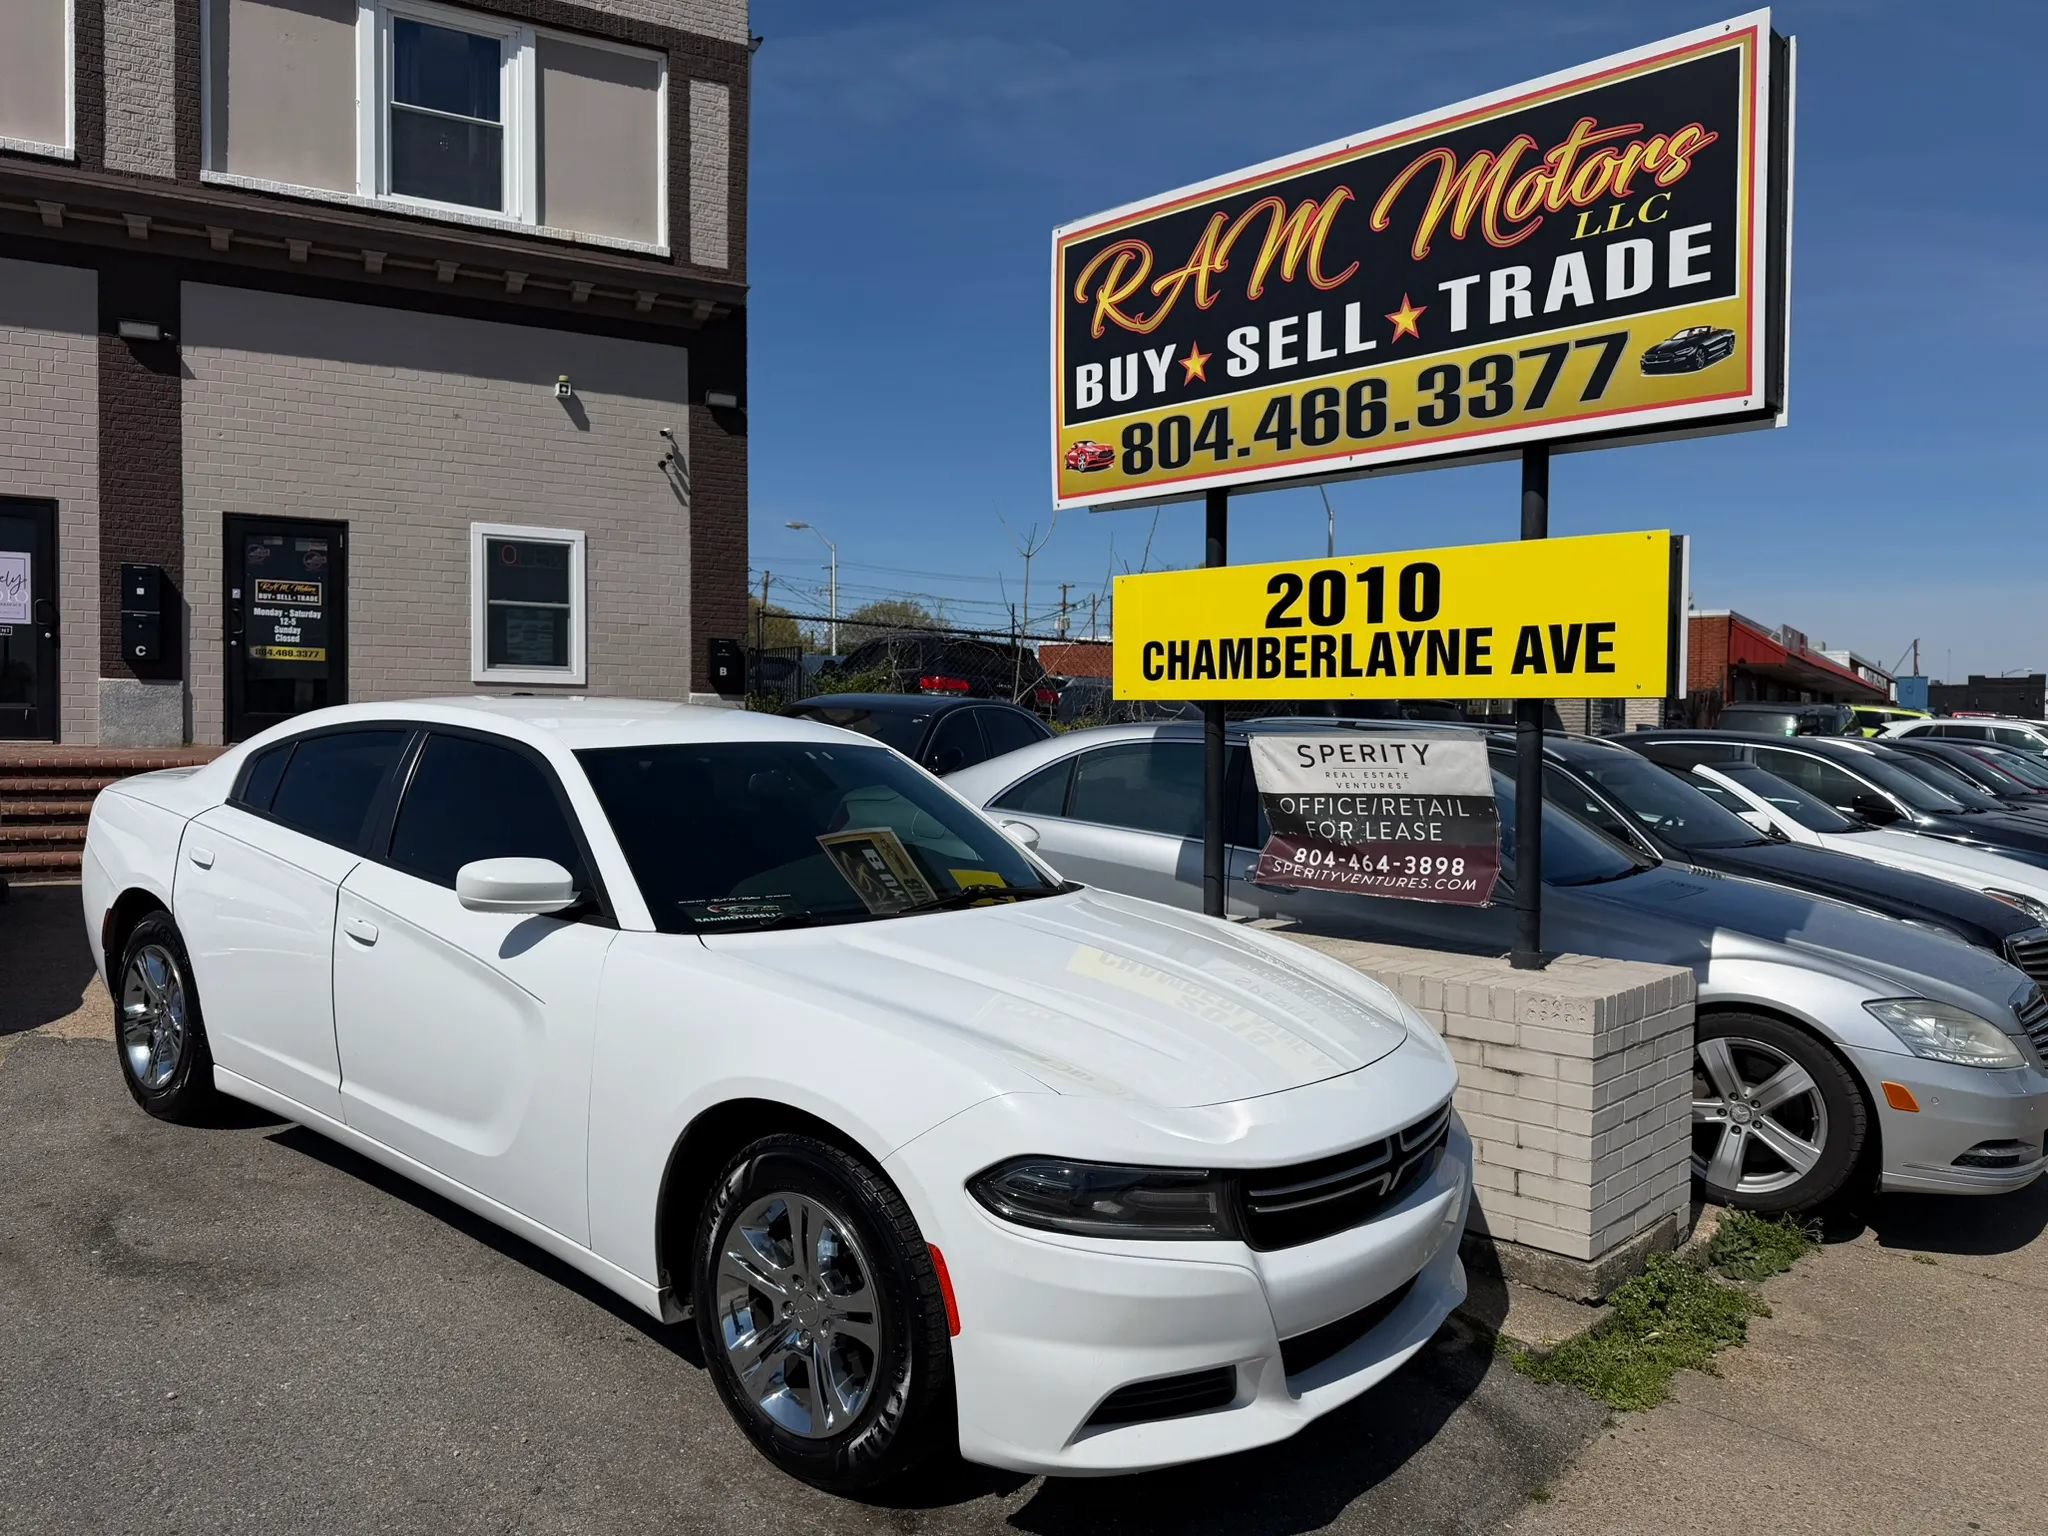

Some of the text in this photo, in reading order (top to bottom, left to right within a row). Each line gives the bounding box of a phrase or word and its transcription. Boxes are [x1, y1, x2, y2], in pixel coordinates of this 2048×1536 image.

[1570, 192, 1671, 240] LLC
[1074, 117, 1719, 339] RAM Motors
[1076, 222, 1712, 410] BUY SELL TRADE
[1121, 330, 1631, 476] 804.466.3377
[276, 593, 292, 601] SELL
[297, 594, 318, 602] TRADE
[1265, 561, 1441, 629] 2010
[253, 607, 283, 617] Monday
[289, 609, 321, 619] Saturday
[280, 617, 296, 626] 12-5
[274, 625, 301, 634] Sunday
[275, 633, 300, 643] Closed
[135, 645, 147, 656] C
[1142, 621, 1617, 682] CHAMBERLAYNE AVE
[719, 666, 727, 676] B
[1297, 743, 1430, 768] SPERITY
[1325, 771, 1409, 780] REAL ESTATE
[1336, 782, 1402, 790] VENTURES
[1279, 797, 1470, 817] OFFICE/RETAIL
[1305, 821, 1443, 842] FOR LEASE
[1294, 848, 1465, 876] 804-464-3898
[1272, 861, 1477, 891] SPERITYVENTURES.COM
